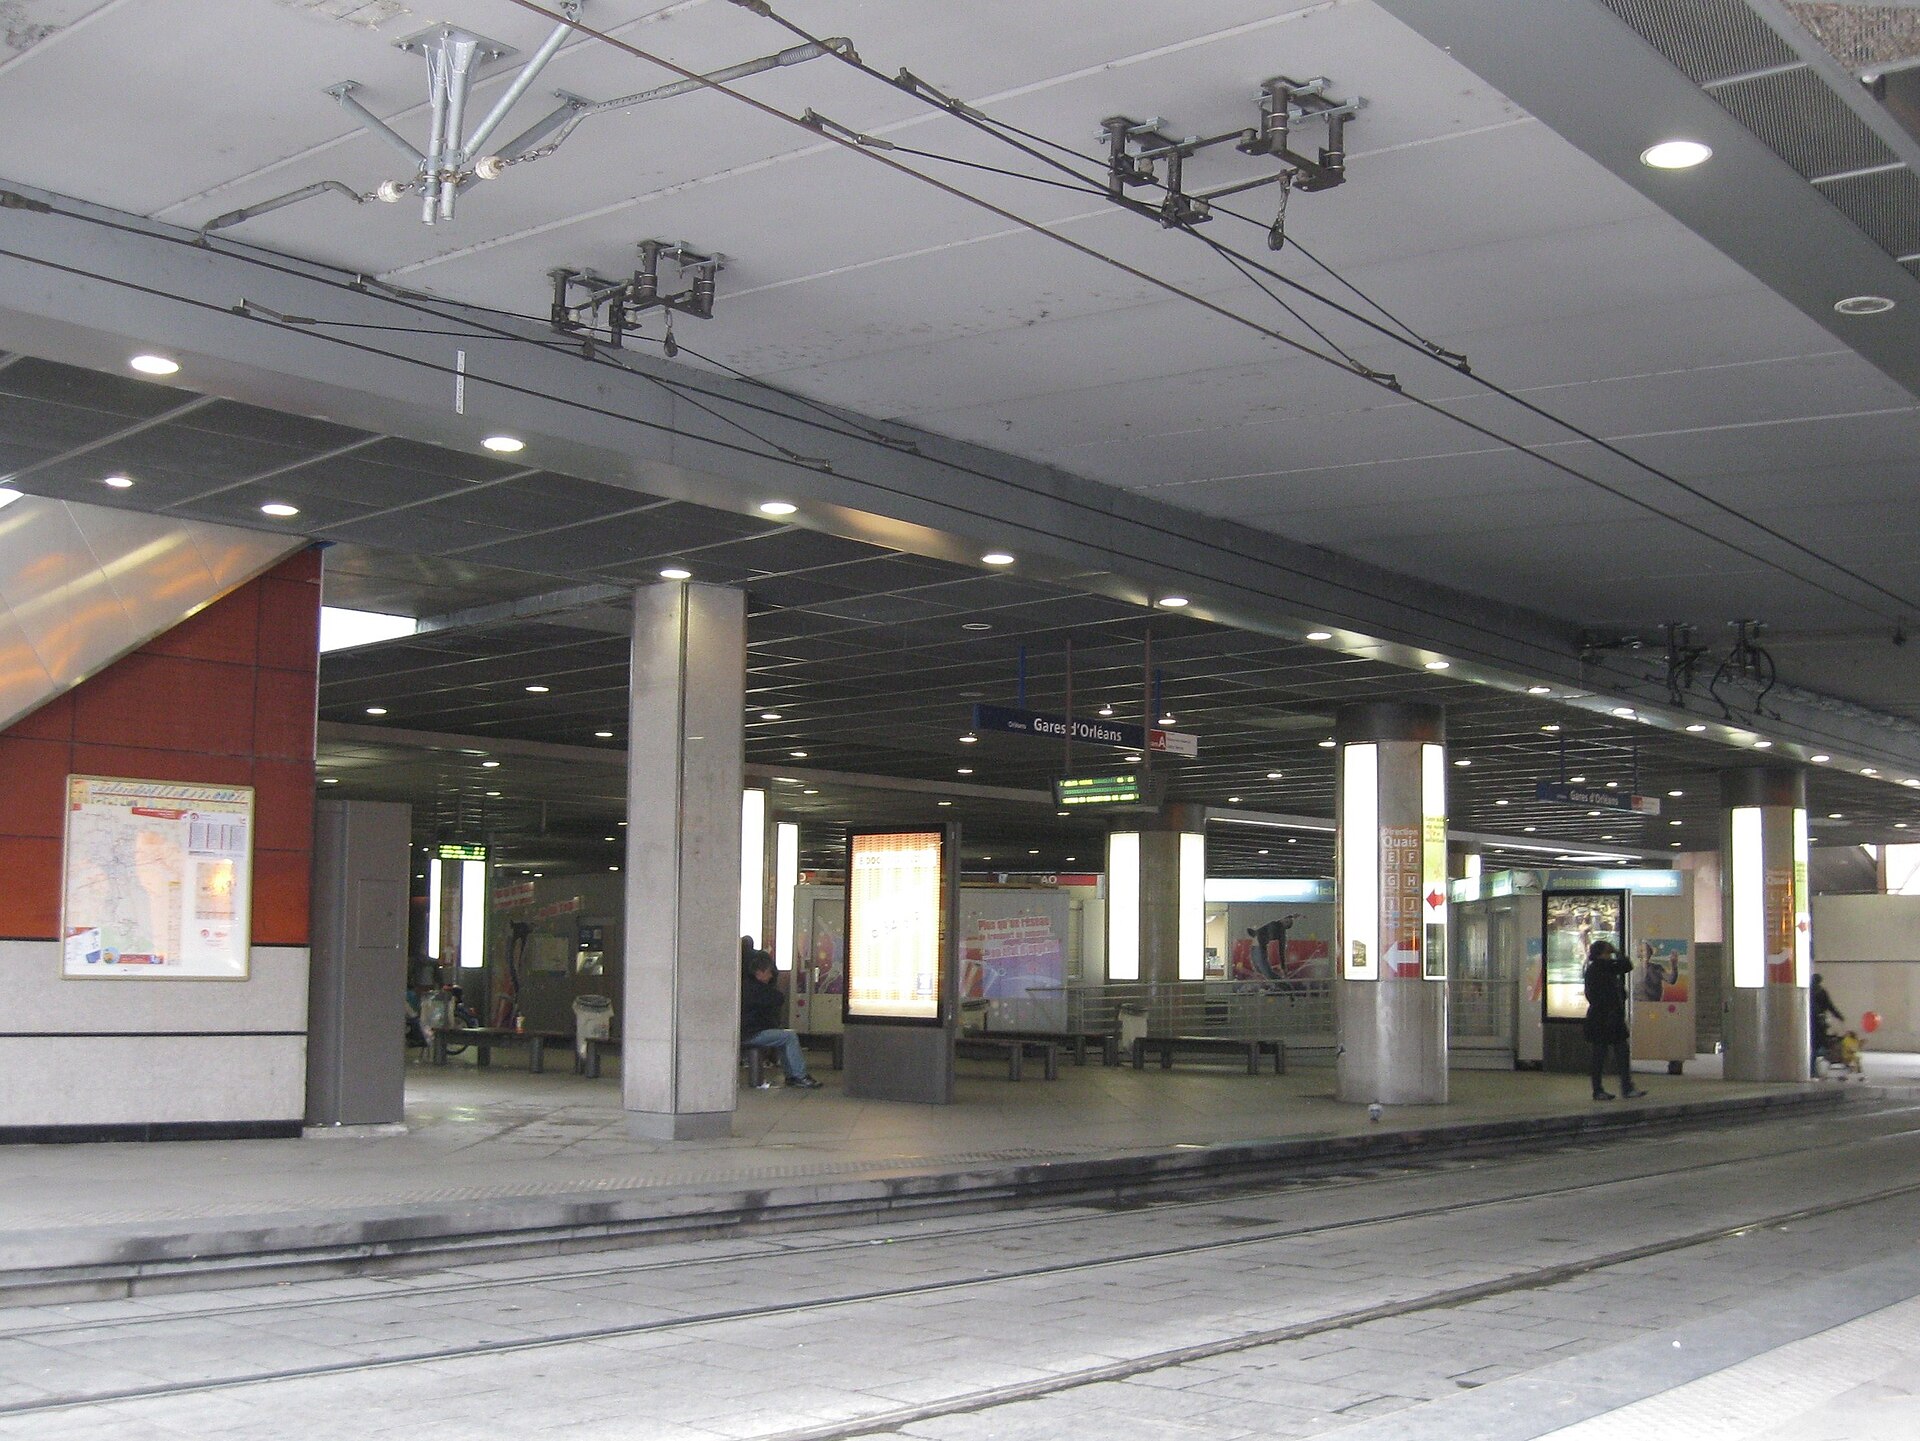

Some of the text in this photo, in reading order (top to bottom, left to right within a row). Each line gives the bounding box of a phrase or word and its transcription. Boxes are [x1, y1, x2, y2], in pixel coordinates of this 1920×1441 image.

[1033, 717, 1122, 742] Gares d'Orléans
[1158, 735, 1167, 748] A
[1384, 835, 1418, 849] Quais
[1388, 851, 1416, 863] E F
[1387, 875, 1416, 886] G H
